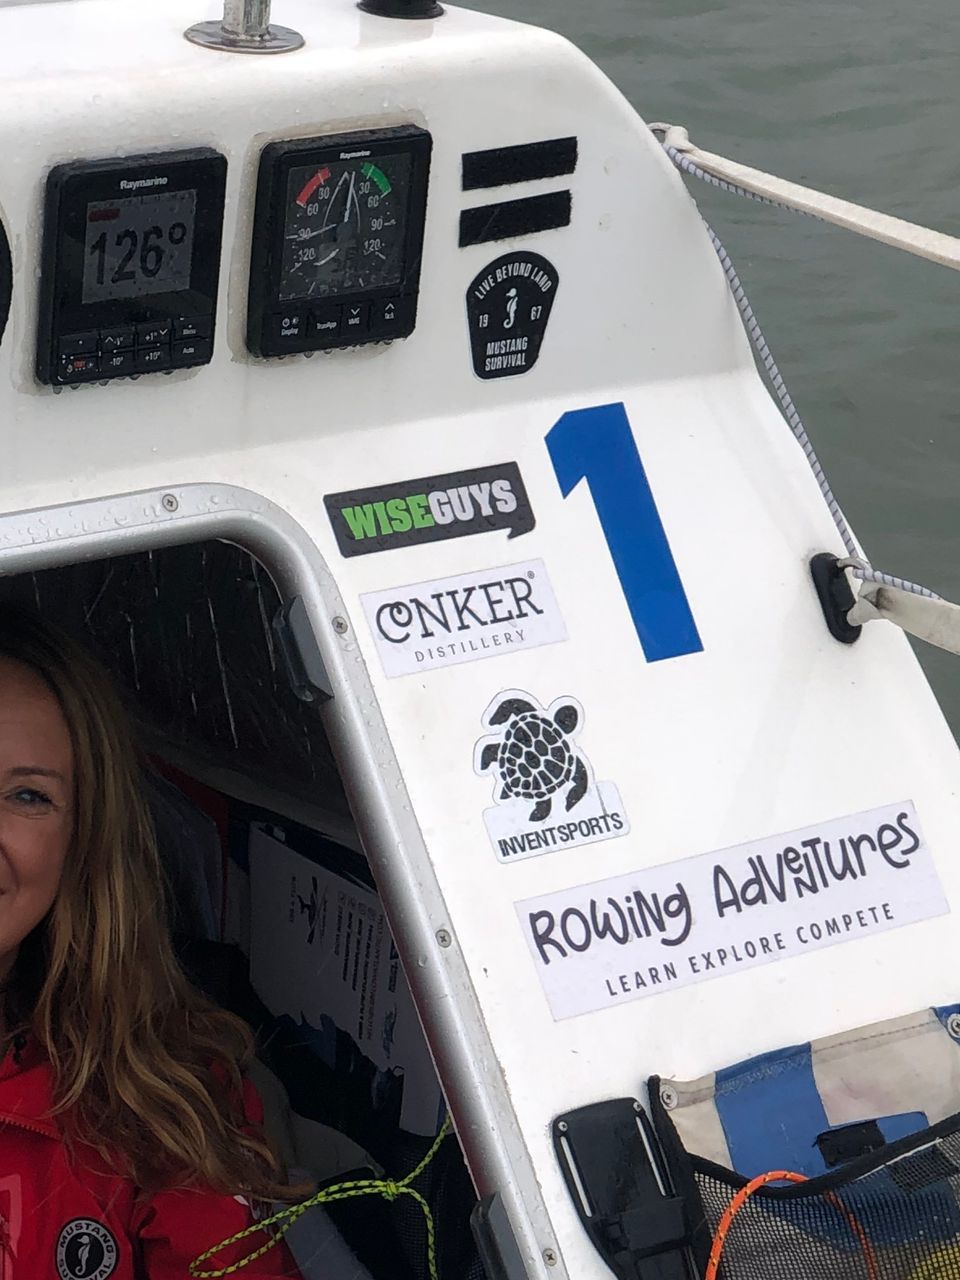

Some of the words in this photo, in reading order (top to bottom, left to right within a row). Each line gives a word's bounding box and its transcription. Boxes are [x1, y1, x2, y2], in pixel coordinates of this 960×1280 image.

[120, 177, 168, 190] Raymarine
[359, 181, 370, 194] 30
[318, 187, 330, 200] 30
[367, 195, 379, 208] 60
[307, 203, 319, 216] 60
[371, 217, 383, 231] 90
[297, 248, 315, 261] 120
[364, 239, 381, 253] 120
[475, 274, 495, 300] LIVE
[496, 262, 532, 282] BEYOND
[531, 267, 552, 292] LAND
[479, 314, 489, 328] 19
[531, 306, 542, 320] 67
[486, 337, 529, 356] MUSTANG
[485, 353, 526, 371] SURVIVAL
[342, 479, 518, 540] WISEGUYS
[543, 402, 704, 664] 1
[414, 629, 525, 662] DISTILLERY
[498, 812, 624, 859] INVENTSPORTS
[605, 961, 679, 999] LEARN
[687, 931, 788, 976] EXPLORE
[796, 902, 896, 946] COMPETE
[60, 1222, 114, 1253] MUSTANG
